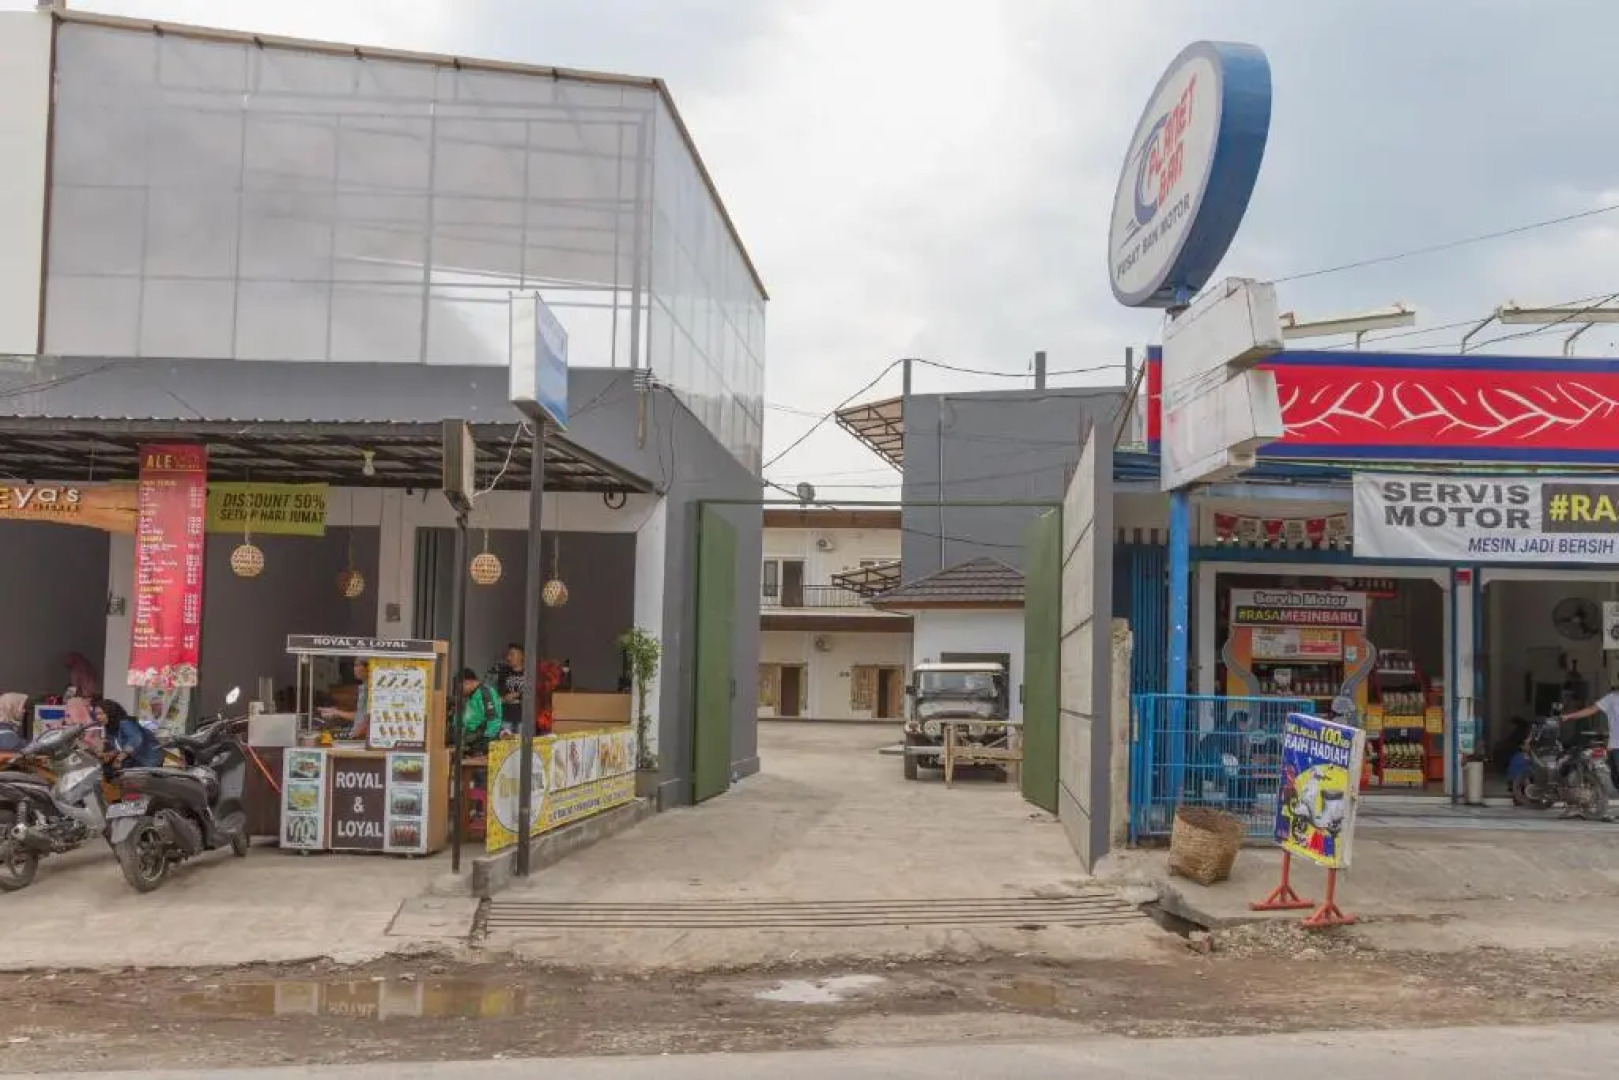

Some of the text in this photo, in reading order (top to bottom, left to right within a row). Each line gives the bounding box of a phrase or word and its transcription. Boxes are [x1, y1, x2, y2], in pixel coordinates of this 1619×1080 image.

[1147, 72, 1197, 190] PLANET
[1158, 140, 1184, 206] BAN
[1117, 193, 1190, 280] PUSAT BAN MOTOR
[294, 494, 325, 509] 50%
[1383, 481, 1530, 504] SERVIS
[220, 508, 259, 521] SETIP
[260, 510, 286, 521] HARI
[1384, 494, 1619, 529] MOTOR #RA
[1468, 537, 1516, 553] MESIN
[1558, 538, 1614, 554] BERSIH
[1253, 591, 1348, 606] Servis Motor
[1239, 609, 1358, 622] #RASAMESINBARU
[313, 638, 408, 648] ROYAL & LOYAL
[1285, 734, 1349, 767] RAIH HADIAH
[335, 771, 384, 789] ROYAL
[353, 796, 365, 814] &
[337, 821, 384, 838] LOYAL
